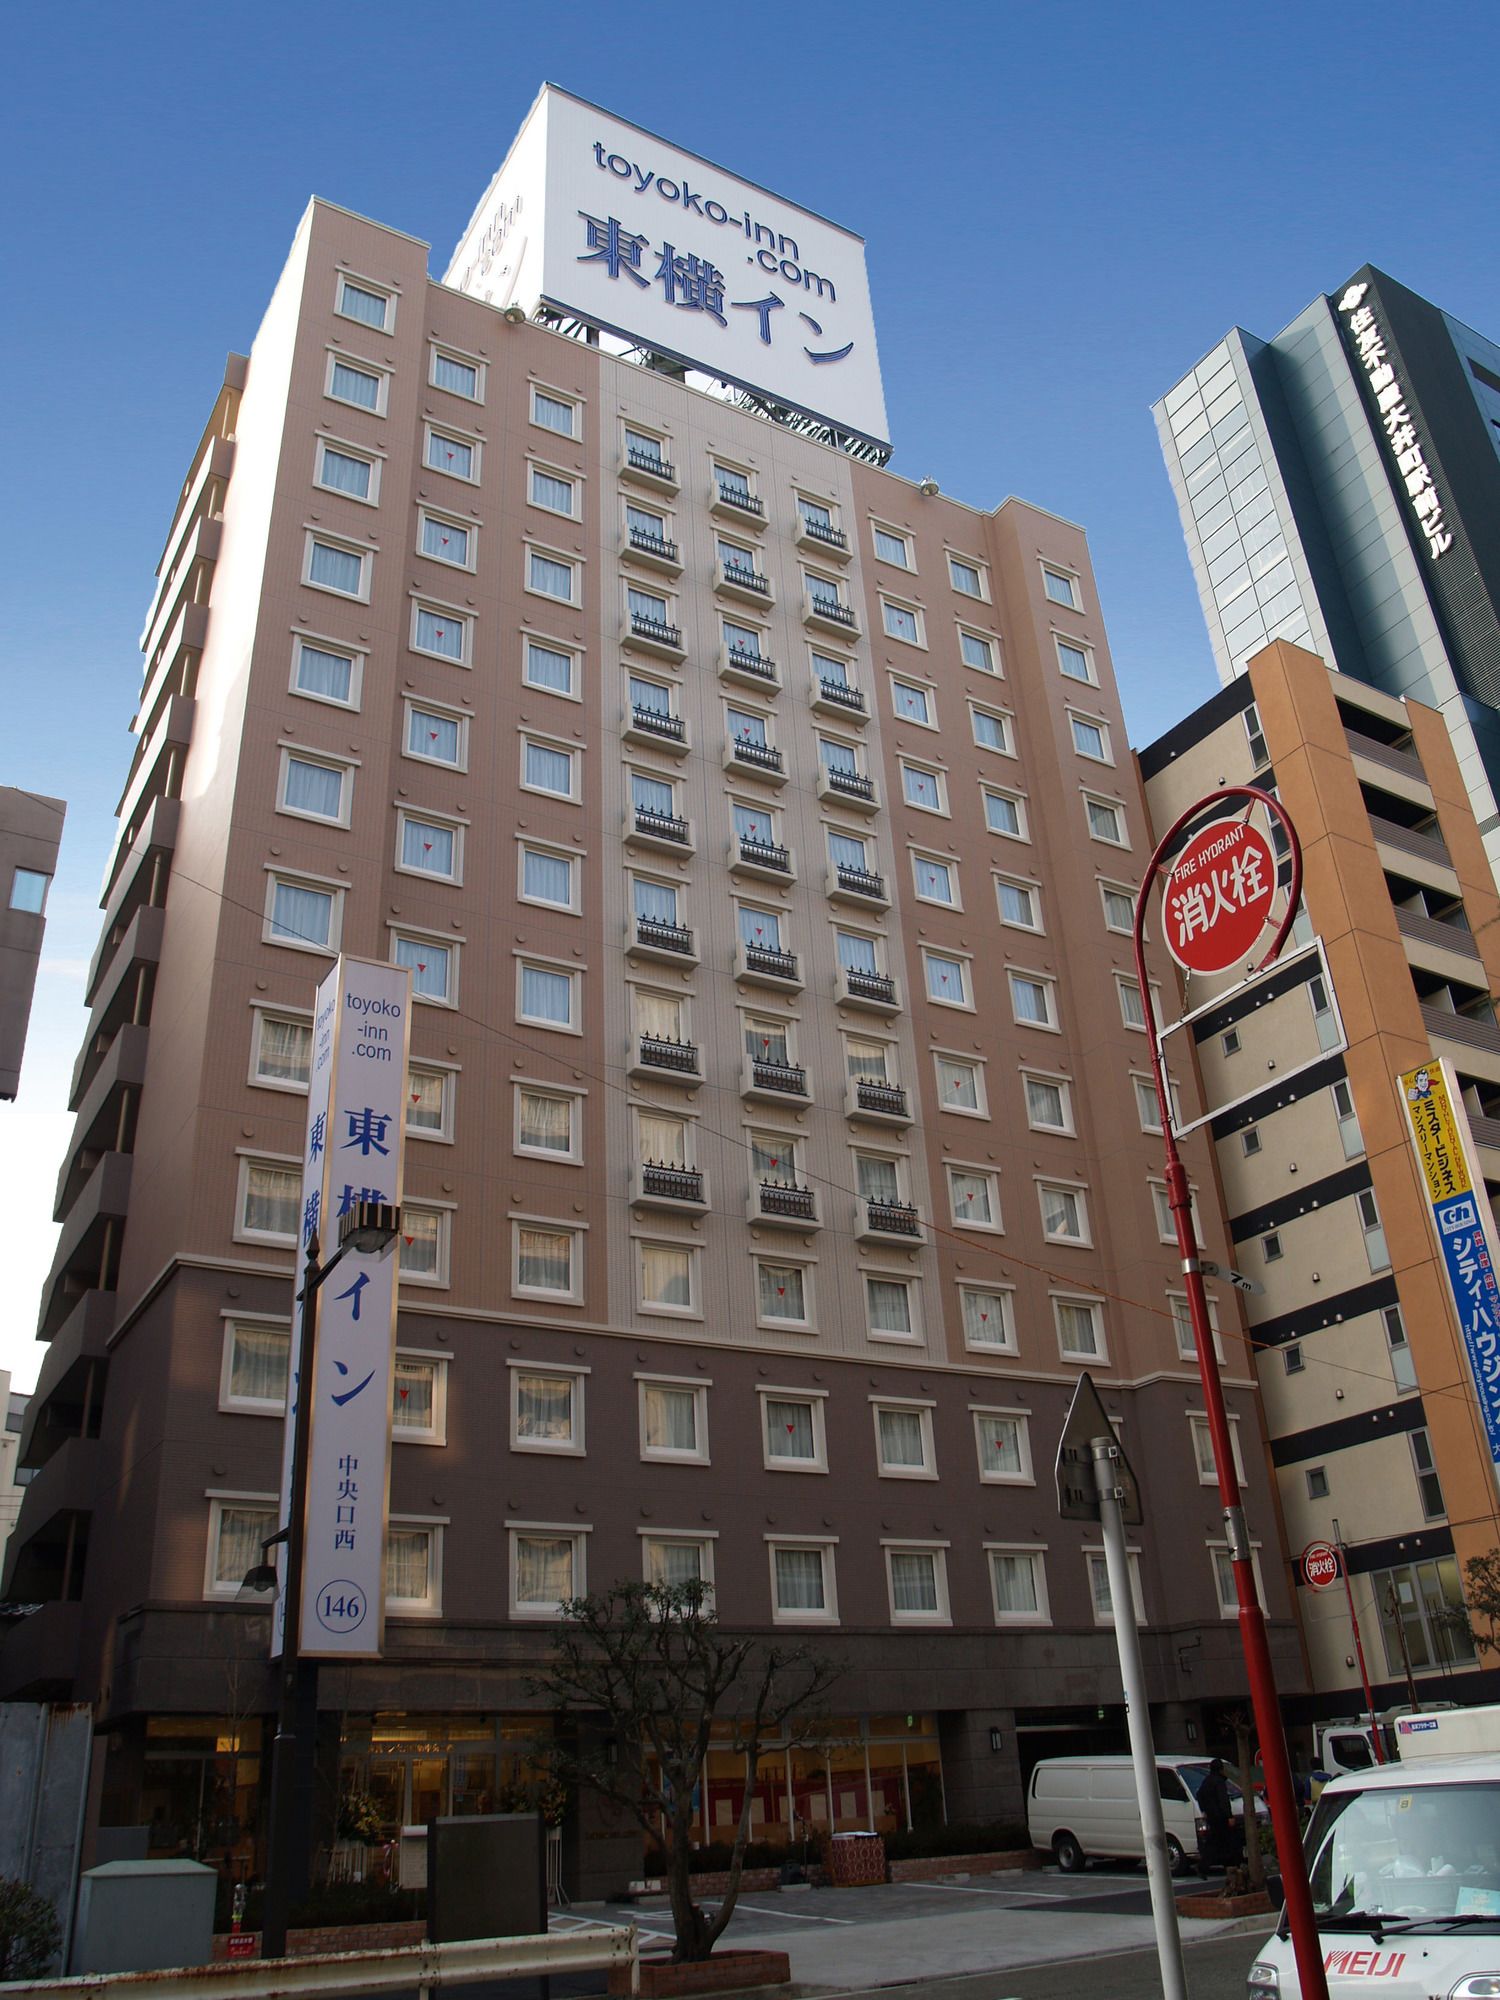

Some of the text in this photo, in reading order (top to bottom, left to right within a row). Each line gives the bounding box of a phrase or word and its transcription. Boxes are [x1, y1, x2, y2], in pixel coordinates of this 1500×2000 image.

[592, 141, 800, 261] toyoko-inn
[576, 210, 855, 365] 東横イン
[746, 247, 837, 303] .com
[1174, 824, 1246, 884] FIRE HYDRANT
[1170, 845, 1269, 948] 消火栓
[346, 991, 401, 1019] toyoko
[357, 1021, 388, 1042] -inn
[351, 1042, 392, 1062] .com
[1412, 1104, 1442, 1199] マンスリーマンション
[1423, 1099, 1457, 1195] ミスタービジネス
[334, 1454, 359, 1552] 中央口西
[1309, 1557, 1335, 1577] 消火栓
[324, 1596, 360, 1619] 146
[1325, 1950, 1407, 1977] MEIJI
